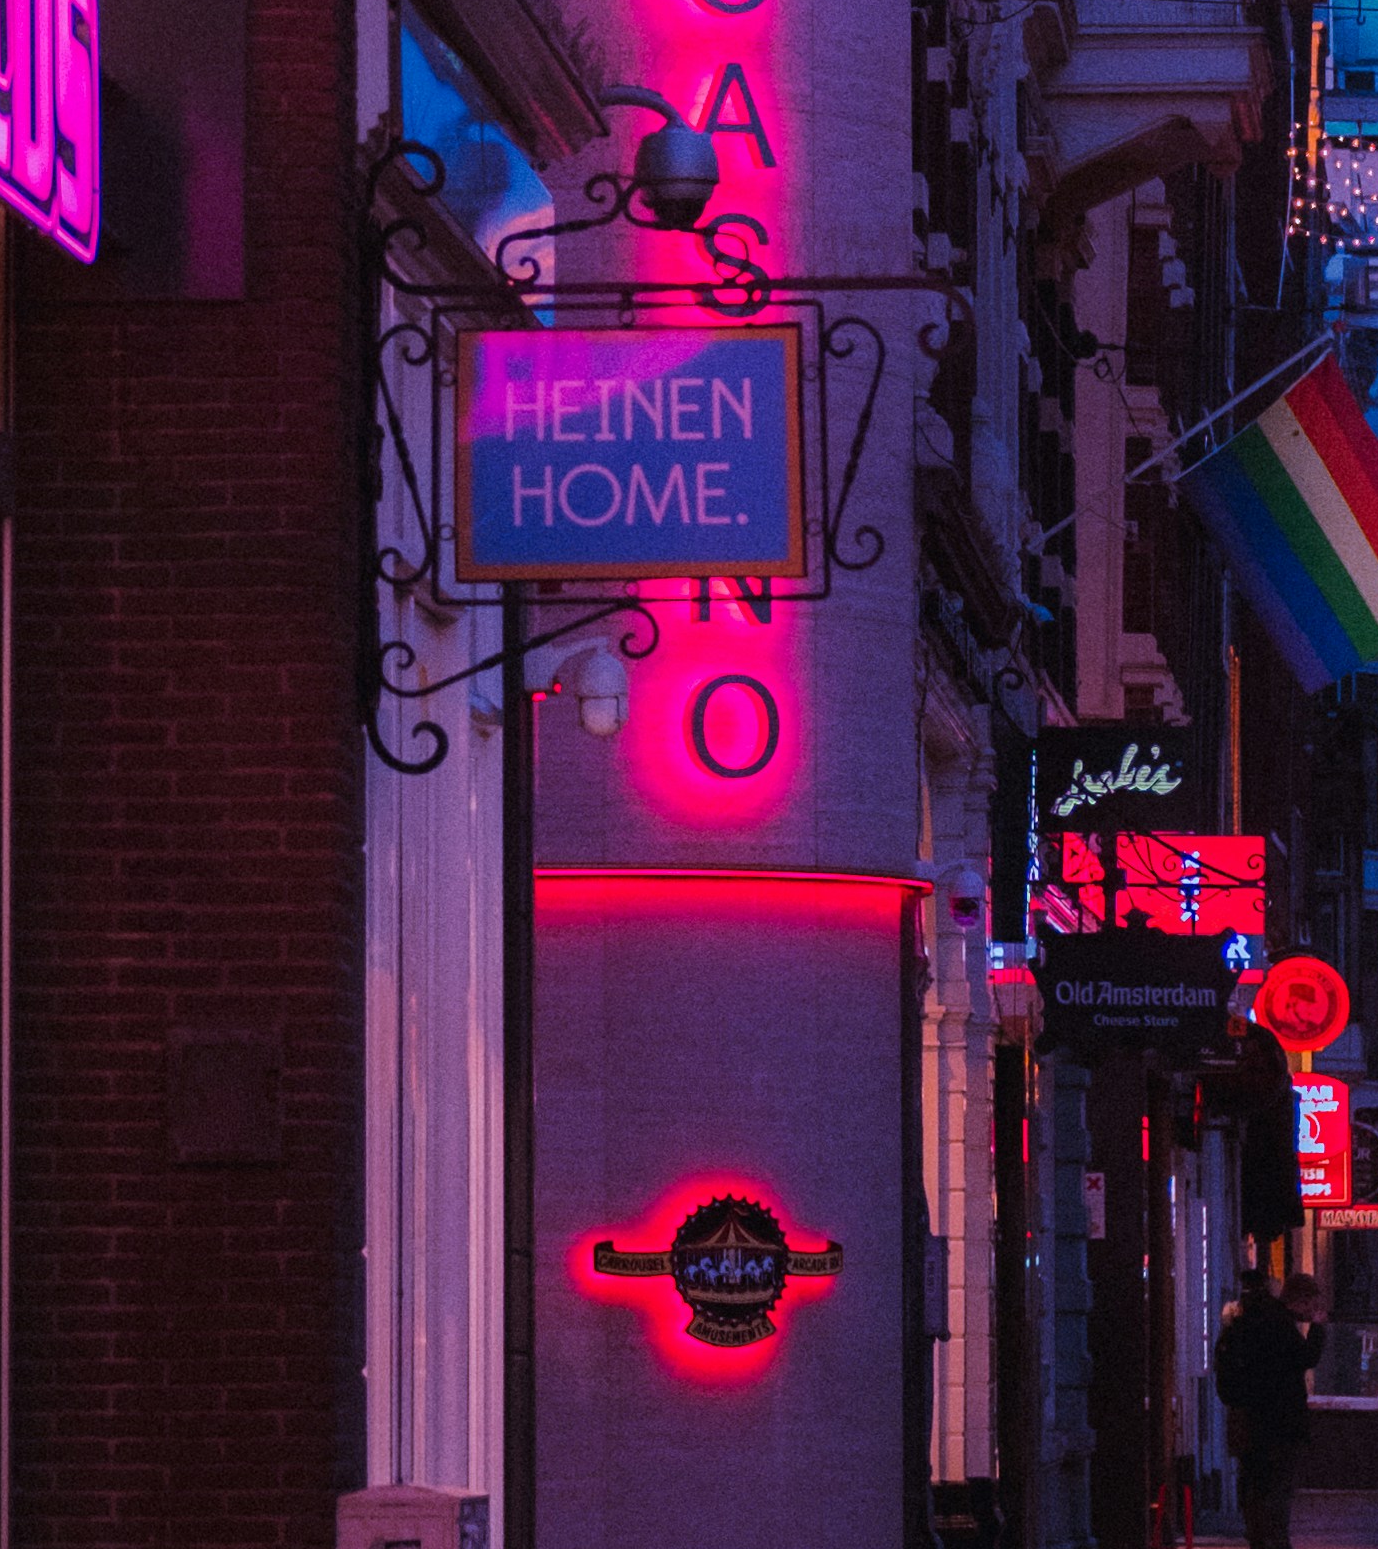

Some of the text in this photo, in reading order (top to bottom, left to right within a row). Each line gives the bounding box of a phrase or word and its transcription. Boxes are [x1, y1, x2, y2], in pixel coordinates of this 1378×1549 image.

[503, 375, 754, 444] HEINEN
[511, 461, 750, 528] HOME.
[1054, 979, 1217, 1007] Old Amsterdam
[1092, 1013, 1180, 1027] Cheese Store
[691, 1320, 772, 1345] AMUSEMENTS
